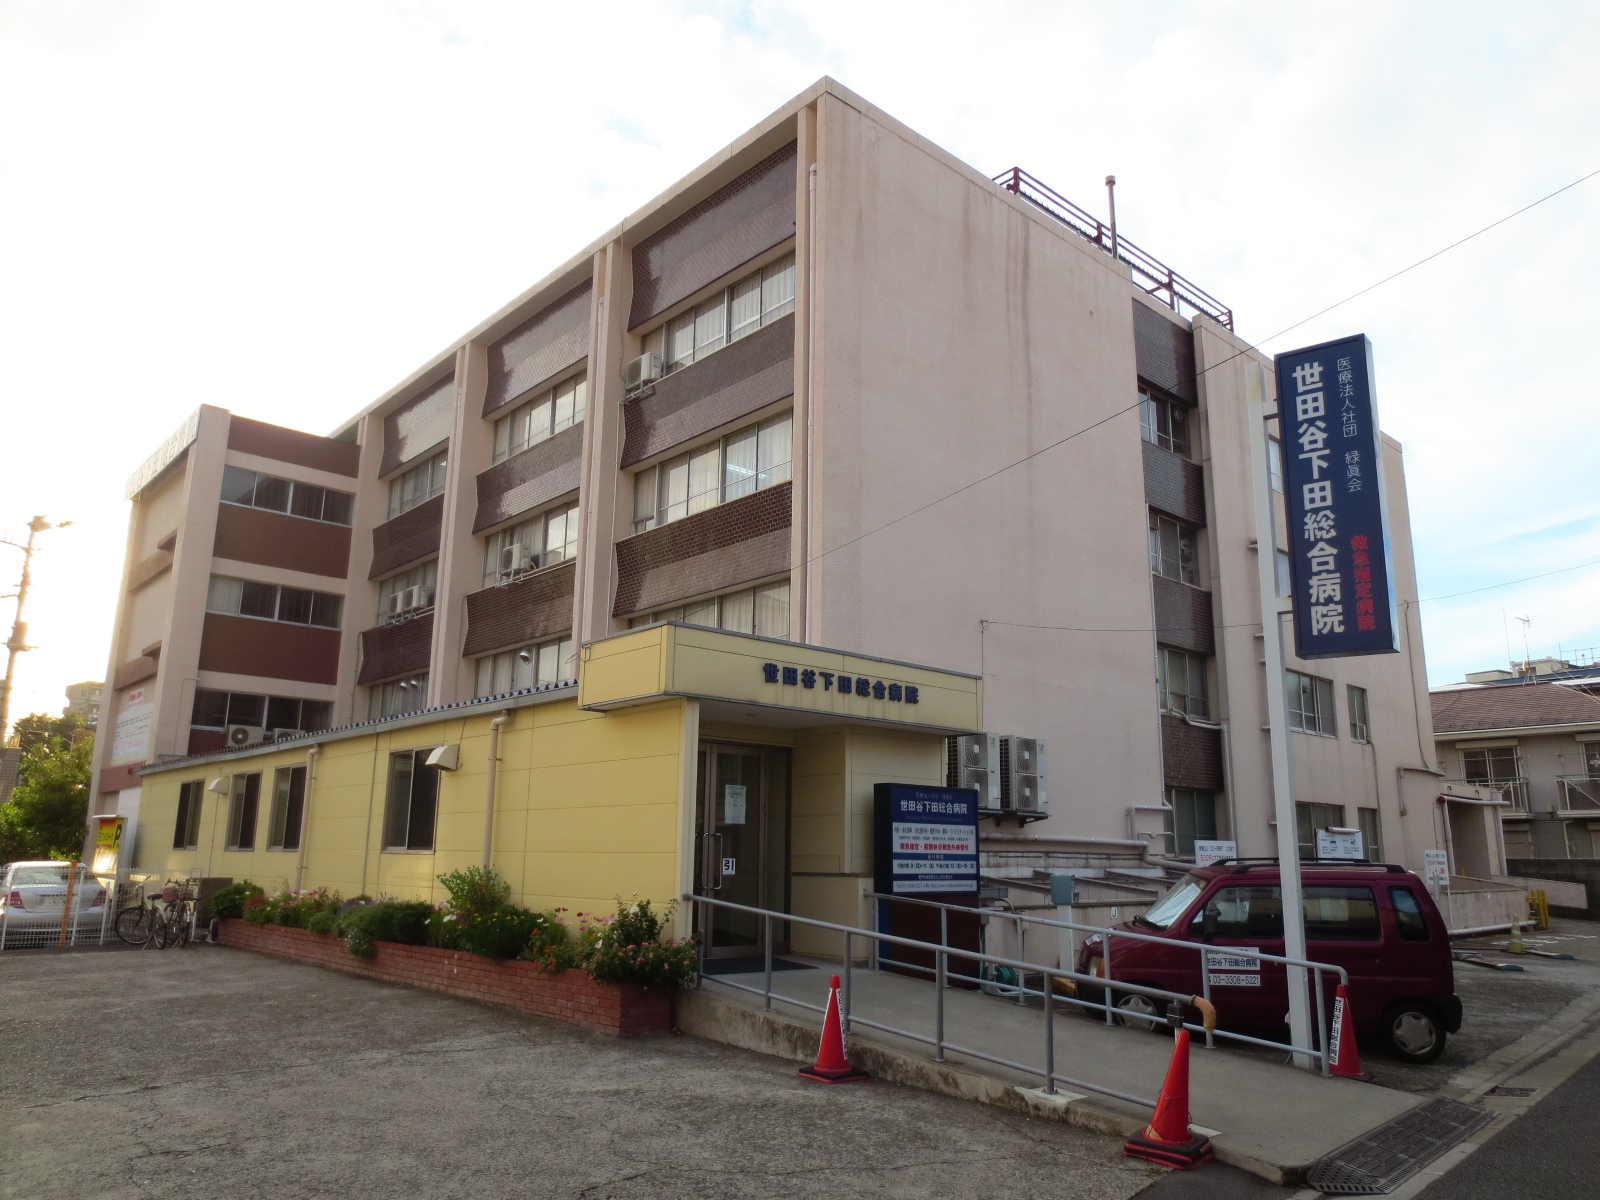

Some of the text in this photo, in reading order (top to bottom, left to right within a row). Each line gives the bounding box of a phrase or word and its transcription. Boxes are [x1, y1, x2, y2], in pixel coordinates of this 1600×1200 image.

[1337, 357, 1357, 437] 医療法人社団
[1292, 361, 1345, 636] 世田谷下田総合病院
[1350, 534, 1376, 631] 救急指定病院
[763, 663, 919, 704] 世田谷下田総合病院
[900, 800, 968, 814] 世田谷下田総合病院
[1213, 975, 1259, 985] 03-3308-5221
